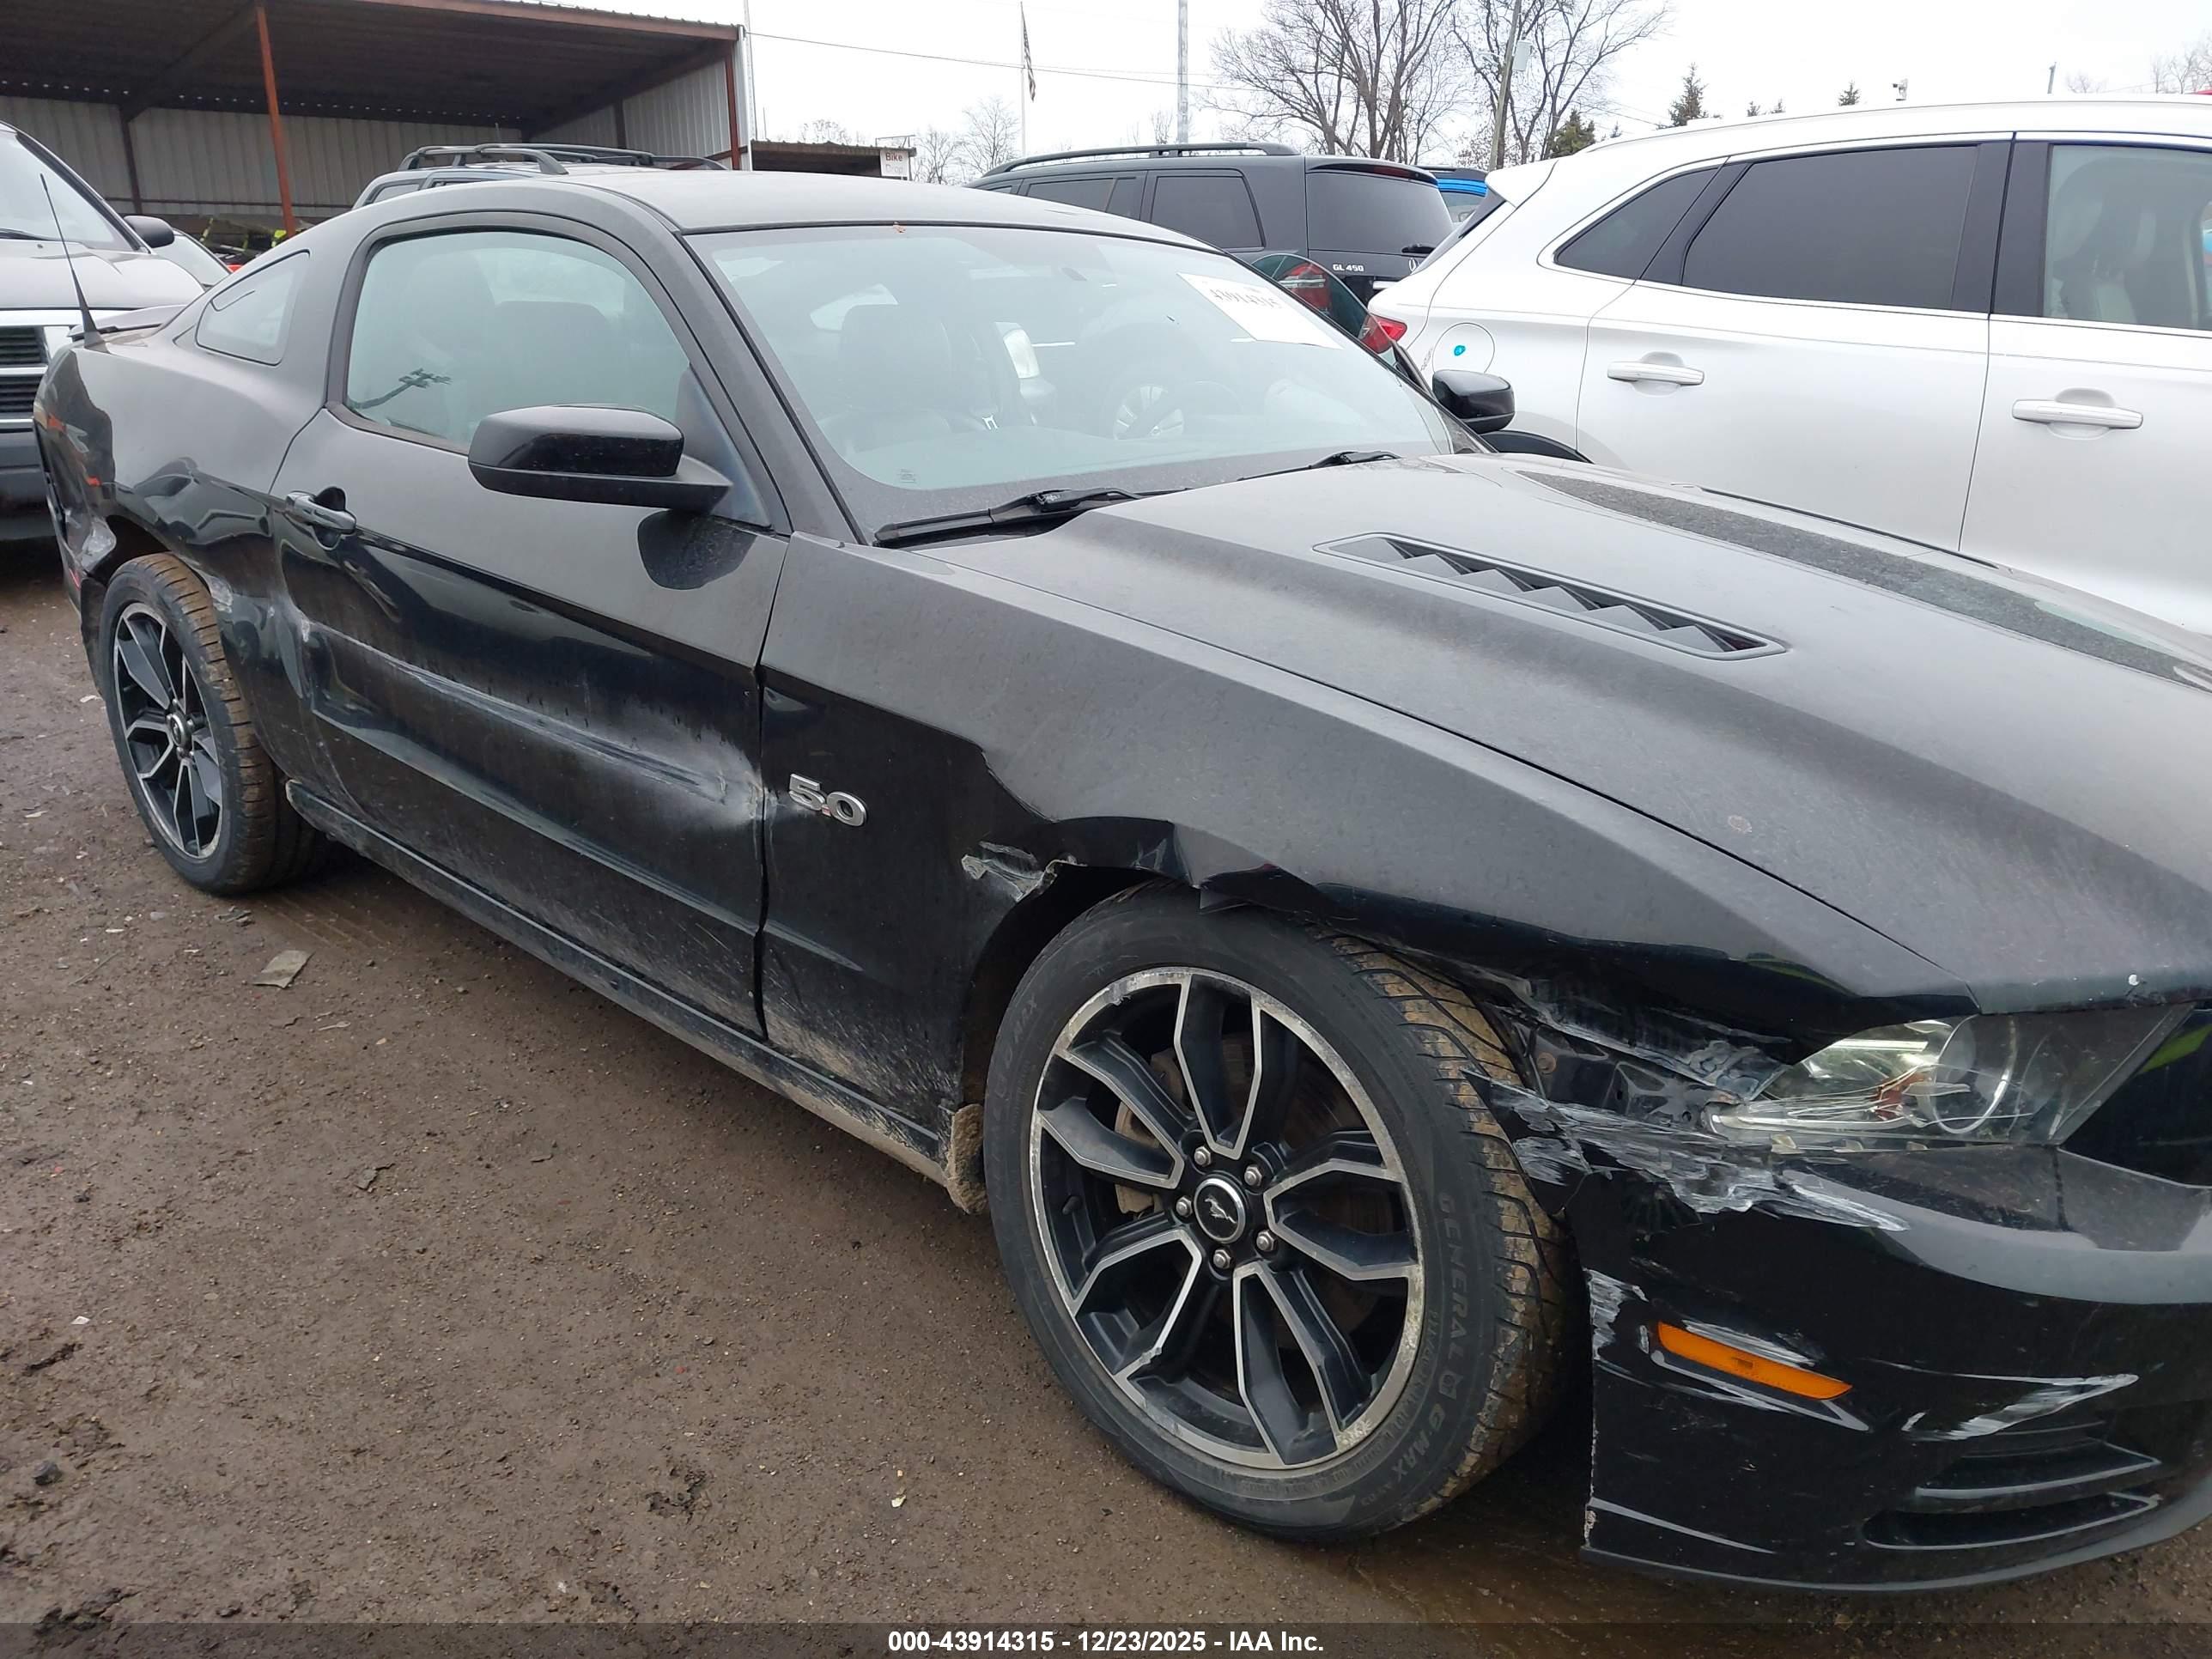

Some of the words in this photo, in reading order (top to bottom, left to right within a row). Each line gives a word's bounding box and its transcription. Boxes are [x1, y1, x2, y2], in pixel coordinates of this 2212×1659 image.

[885, 152, 903, 161] Bike
[885, 164, 903, 174] Drop
[788, 773, 867, 827] 5.0
[1437, 1194, 1469, 1358] GENERAL
